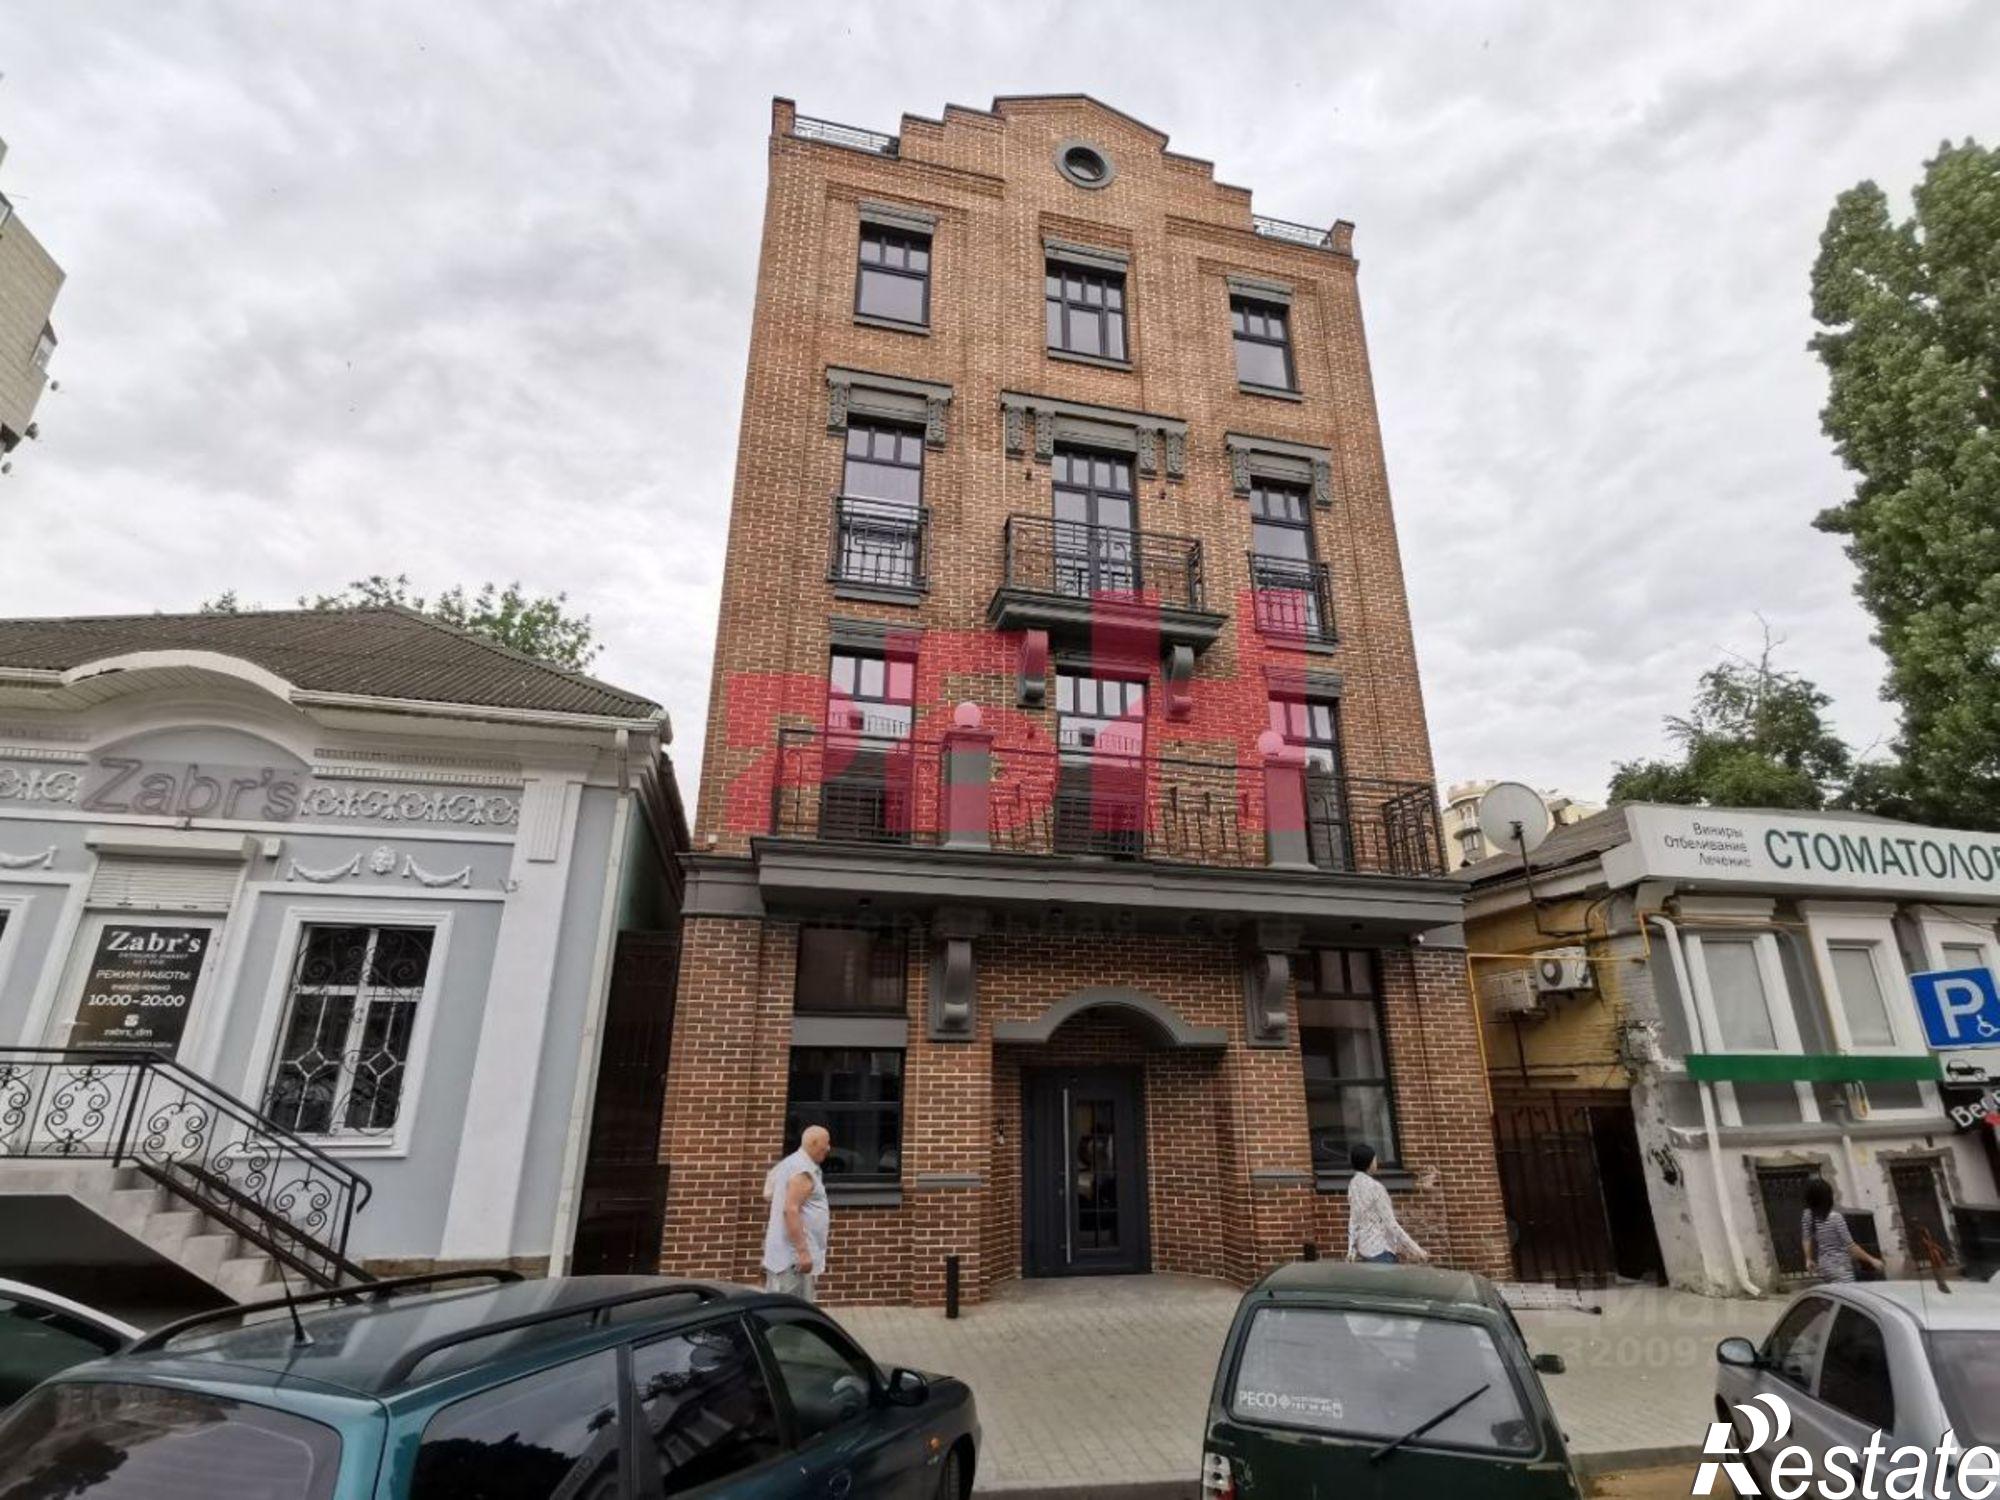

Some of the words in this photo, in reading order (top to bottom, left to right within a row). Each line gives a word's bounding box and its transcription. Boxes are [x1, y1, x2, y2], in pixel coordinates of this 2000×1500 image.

[81, 757, 299, 823] Zabr's
[1693, 822, 1743, 839] Виниры
[1664, 835, 1748, 853] Отбеливание
[1699, 852, 1752, 868] Лечение
[107, 931, 201, 953] Zabr's
[96, 969, 140, 979] РЕЖИМ
[1933, 978, 1985, 1039] P
